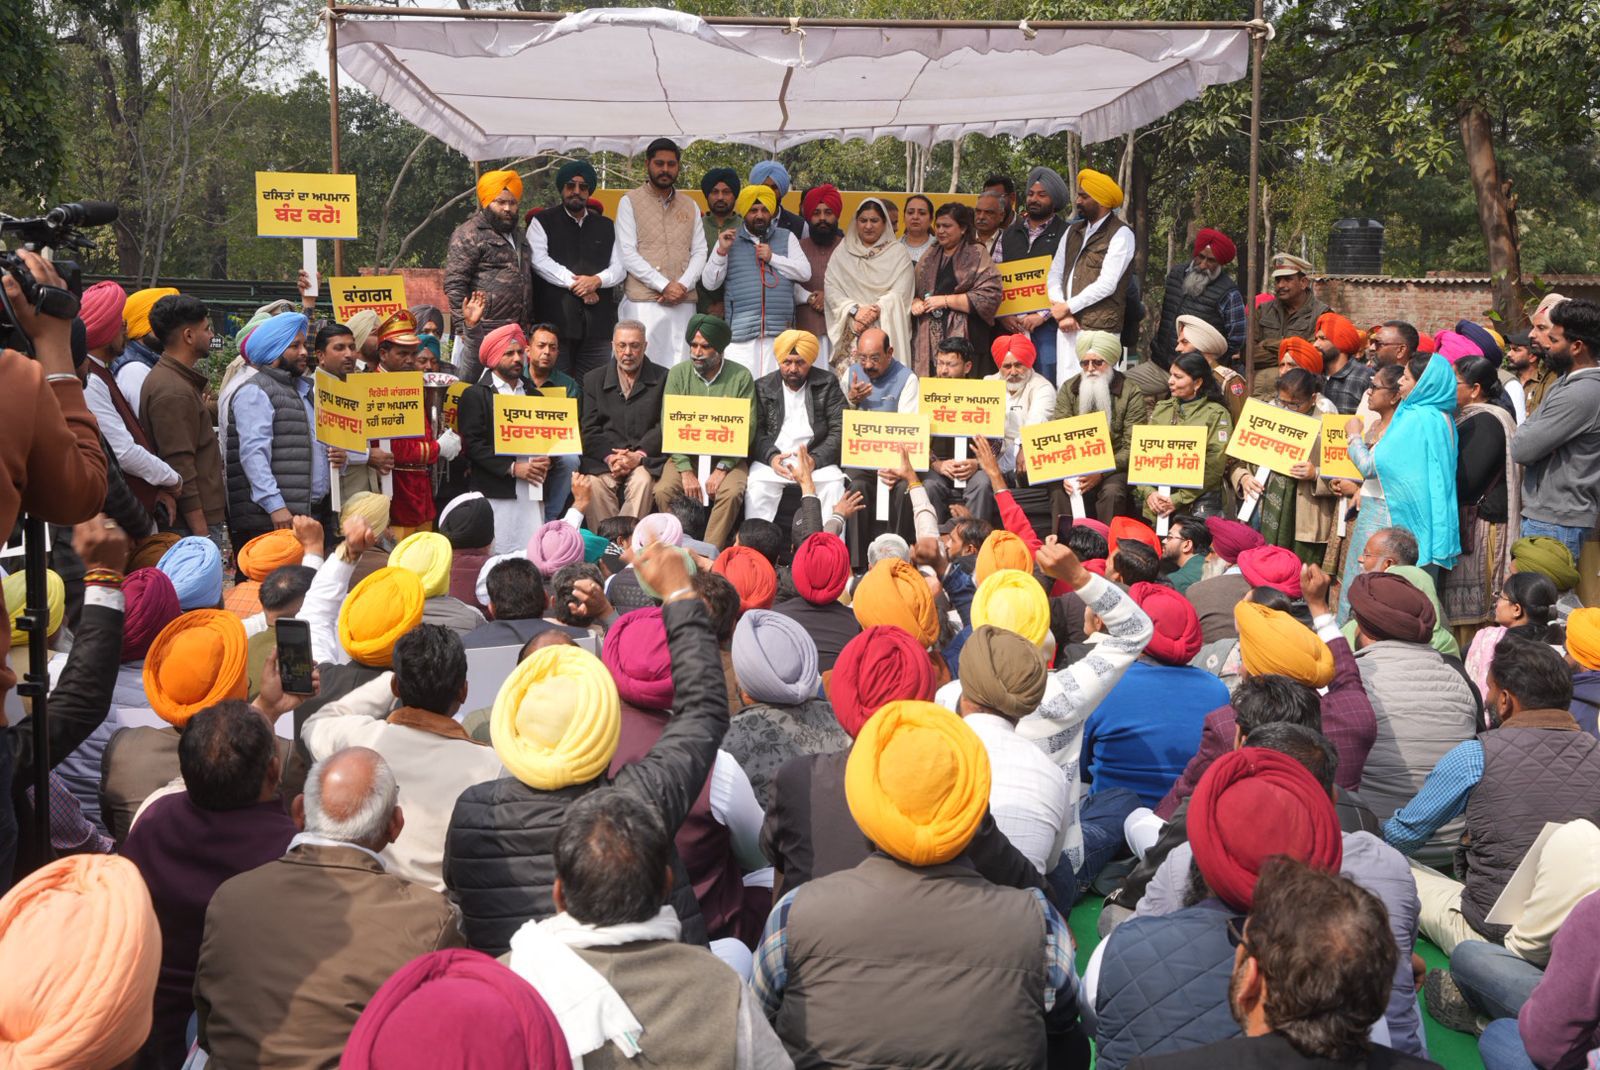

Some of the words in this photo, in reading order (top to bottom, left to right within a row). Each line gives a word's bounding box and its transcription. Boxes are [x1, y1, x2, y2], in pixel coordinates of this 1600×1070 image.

[262, 189, 294, 201] ਦਲਿਤਾਂ
[298, 192, 309, 201] ਦਾ
[312, 192, 350, 203] ਅਪਮਾਨ
[274, 203, 302, 222] ਬੰਦ
[307, 204, 341, 224] ਕਰੋ!
[1014, 269, 1044, 282] ਬਾਜਵਾ
[342, 285, 392, 303] ਕਾਂਗਰਸ
[335, 395, 359, 411] ਬਾਜਵਾ
[377, 401, 386, 411] ਦਾ
[387, 400, 418, 411] ਅਪਮਾਨ
[954, 395, 964, 403] ਦਾ
[966, 396, 999, 404] ਅਪਮਾਨ
[503, 409, 532, 423] ਪ੍ਰਤਾਪ
[535, 410, 568, 421] ਬਾਜਵਾ
[699, 414, 708, 422] ਦਾ
[933, 405, 957, 422] ਬੰਦ
[961, 407, 990, 424] ਕਰੋ!
[500, 425, 574, 441] ਮੁਰਦਾਬਾਦ!
[678, 424, 701, 441] ਬੰਦ
[705, 425, 734, 442] ਕਰੋ!
[853, 424, 881, 437] ਪ੍ਰਤਾਪ
[885, 426, 919, 436] ਬਾਜਵਾ
[1249, 415, 1277, 431] ਪ੍ਰਤਾਪ
[1278, 424, 1308, 440] ਬਾਜਵਾ
[848, 438, 924, 455] ਮੁਰਦਾਬਦ!
[1032, 434, 1061, 450] ਪ੍ਰਤਾਪ
[1064, 427, 1098, 441] ਬਾਜਵਾ
[1140, 439, 1164, 452] ਪ੍ਰਤਾਪ
[1167, 440, 1197, 450] ਬਾਜਵਾ
